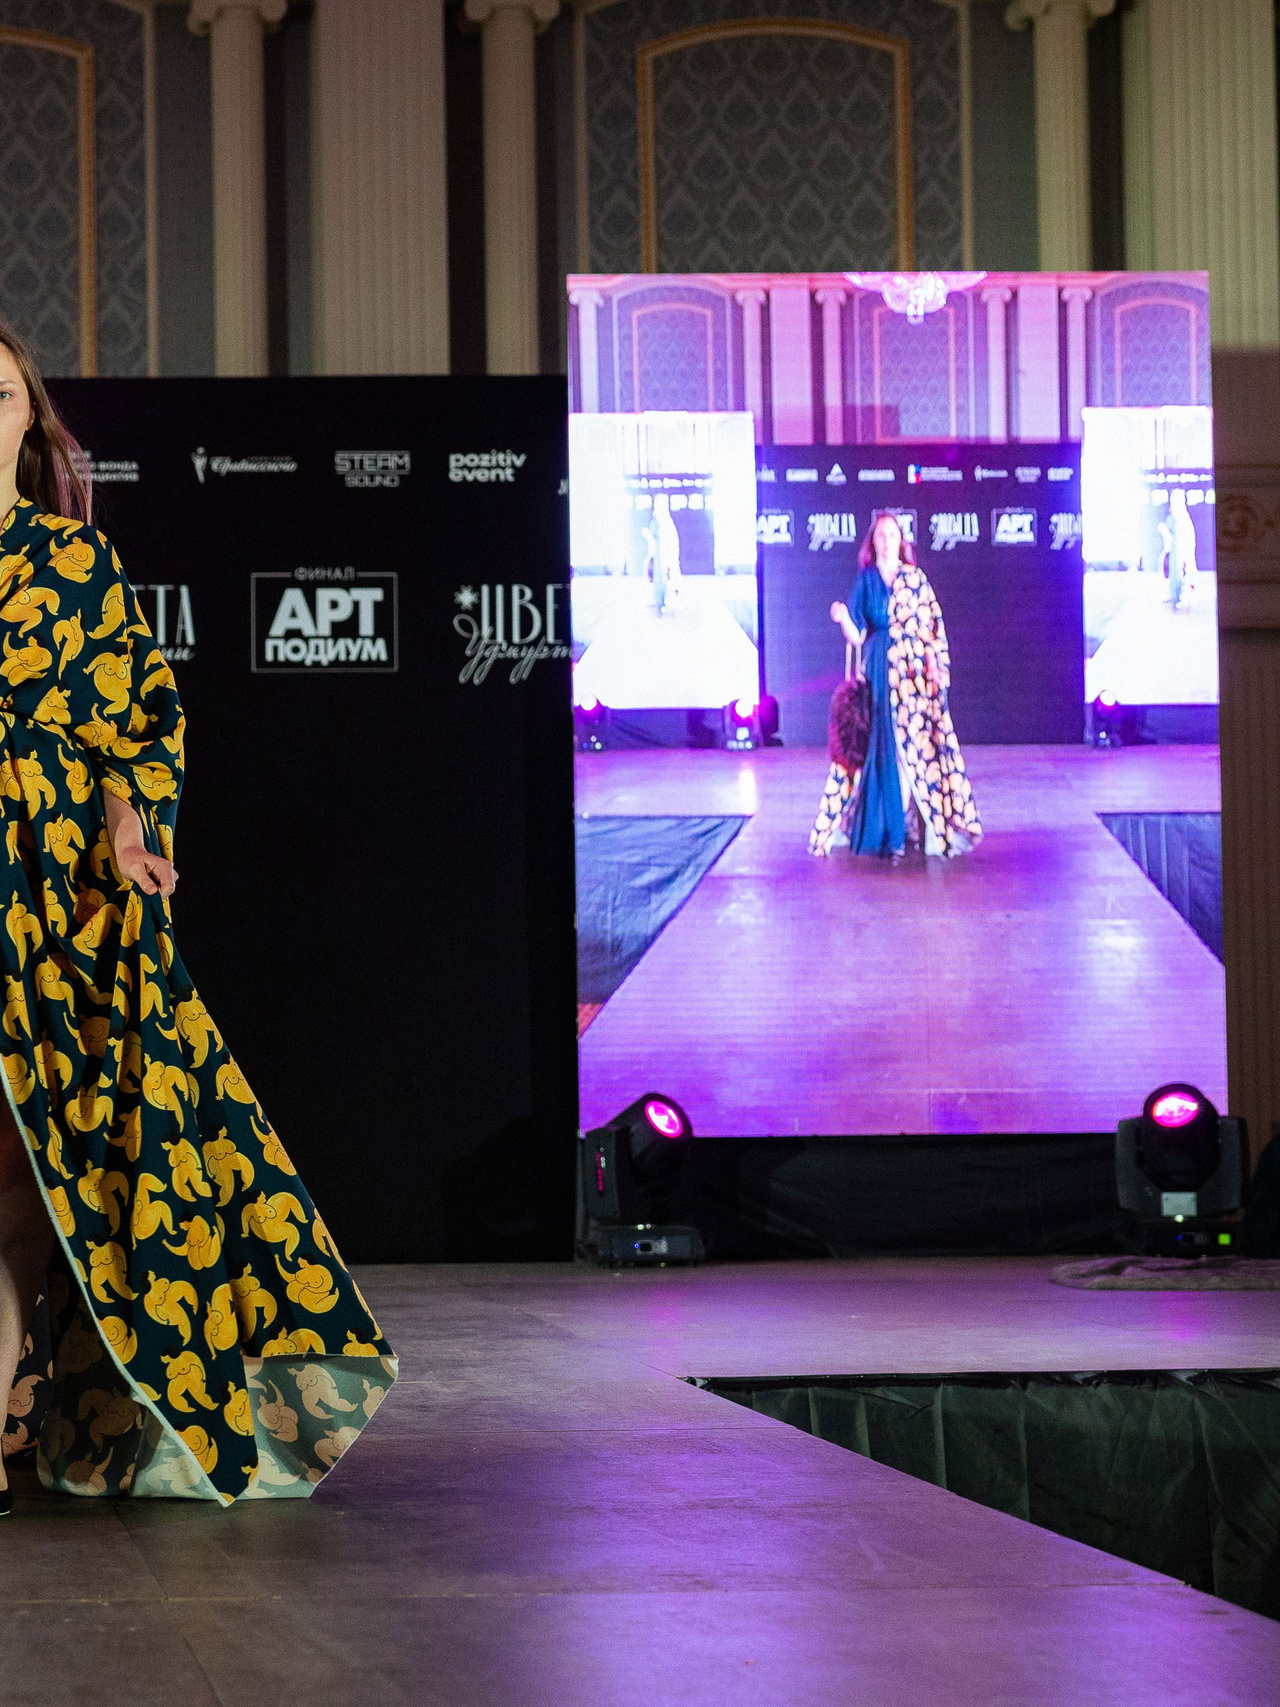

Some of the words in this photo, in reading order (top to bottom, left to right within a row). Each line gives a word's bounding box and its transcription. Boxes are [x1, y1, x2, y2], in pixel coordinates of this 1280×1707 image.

[334, 453, 410, 471] STEAM
[449, 449, 527, 469] pozitiv
[345, 474, 399, 487] SOUND
[449, 467, 515, 482] event
[293, 567, 355, 581] ФИНАЛ
[268, 587, 384, 636] АРТ
[481, 584, 570, 648] ЦВЕ
[265, 638, 388, 666] ПОДИУМ
